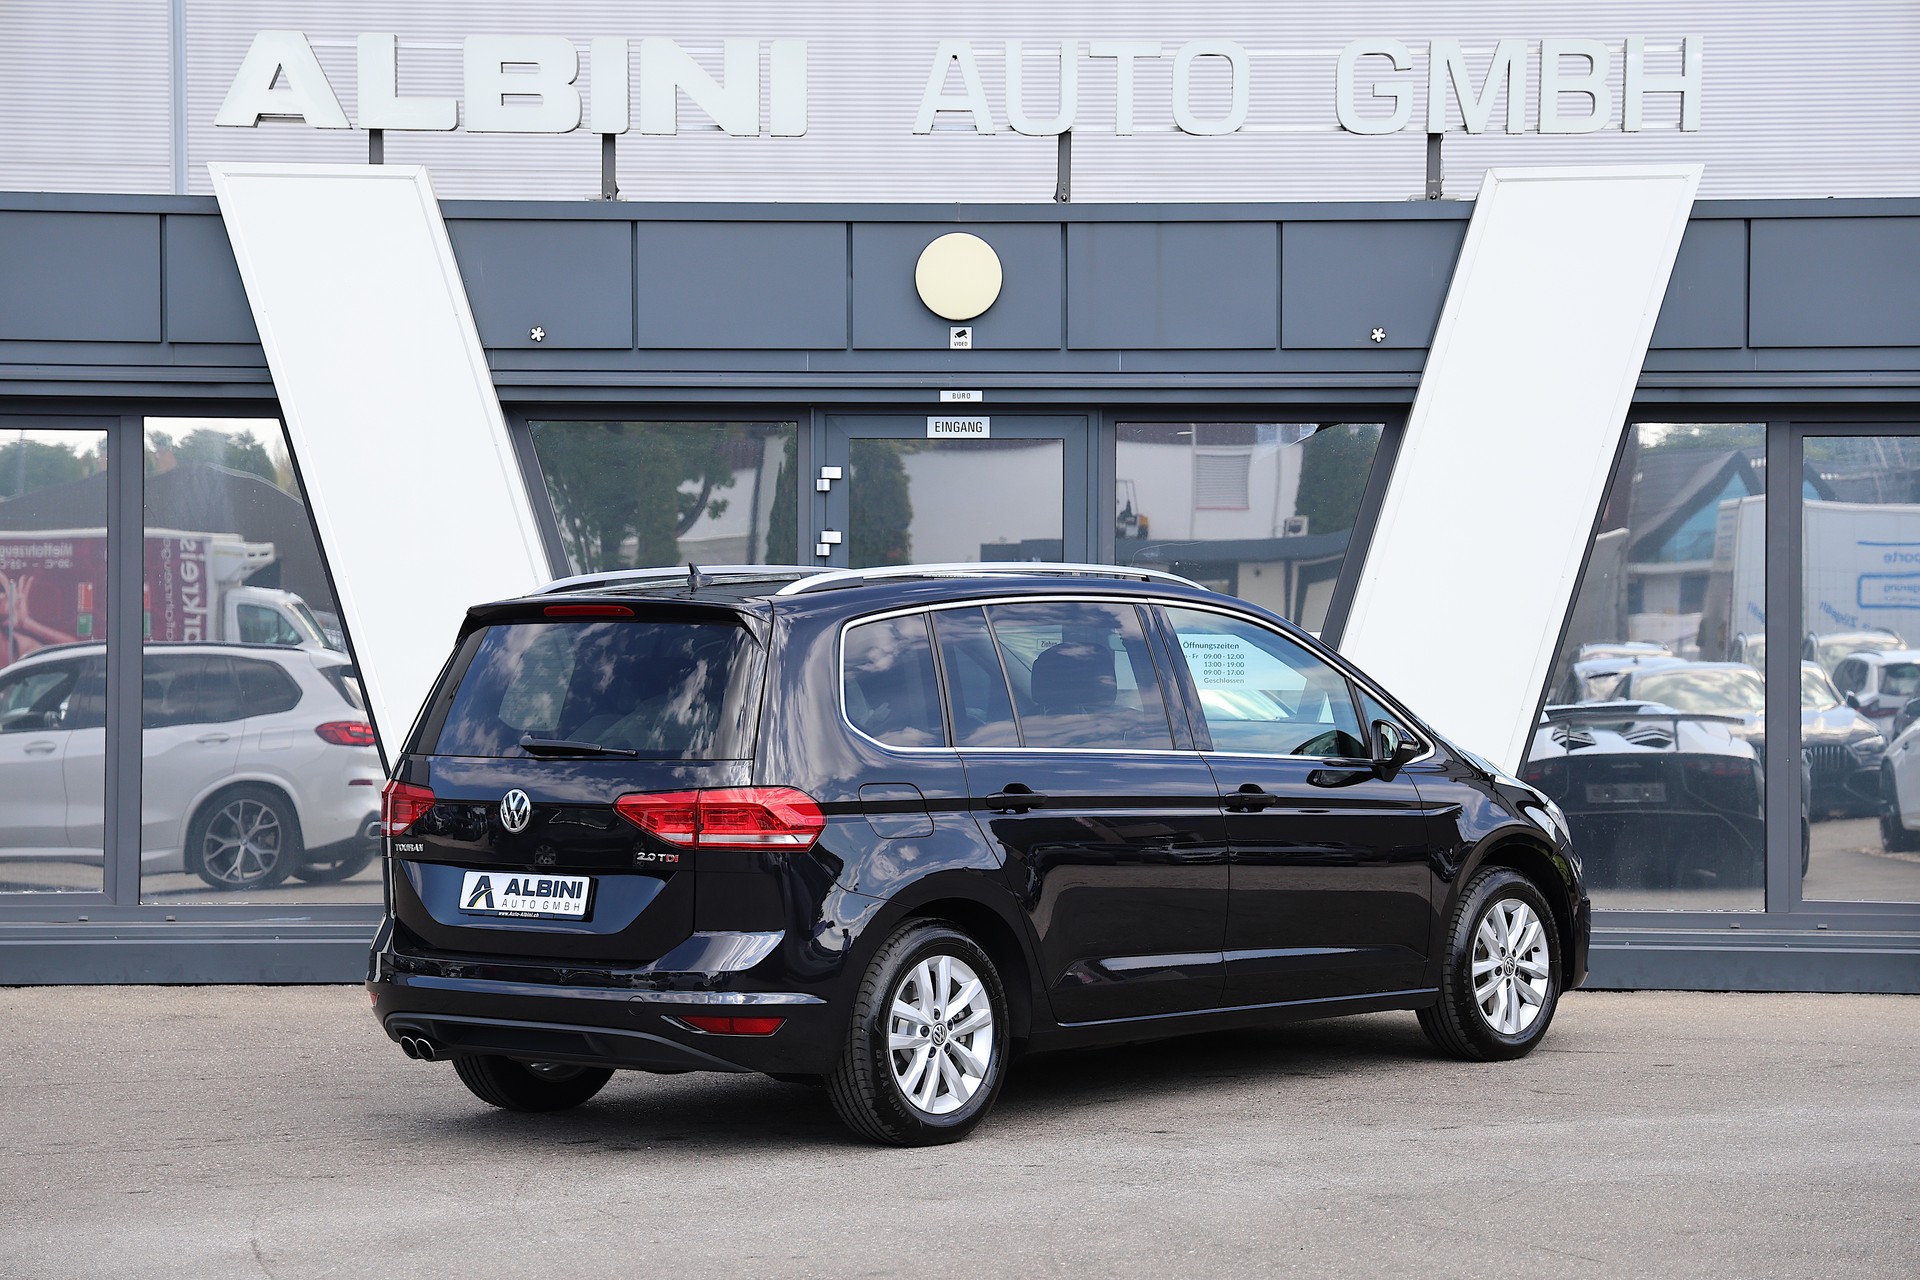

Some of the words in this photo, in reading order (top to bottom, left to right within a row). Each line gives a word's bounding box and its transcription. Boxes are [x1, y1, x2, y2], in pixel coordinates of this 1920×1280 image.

[214, 30, 808, 137] ALBINI
[913, 38, 1250, 137] AUTO
[1335, 36, 1704, 136] GMBH
[952, 392, 971, 400] BÜRO
[935, 421, 983, 433] EINGANG
[395, 843, 424, 852] TOURAN
[658, 853, 680, 863] TDI
[503, 878, 584, 899] ALBINI
[501, 898, 537, 910] AUTO
[542, 900, 580, 912] GMBH
